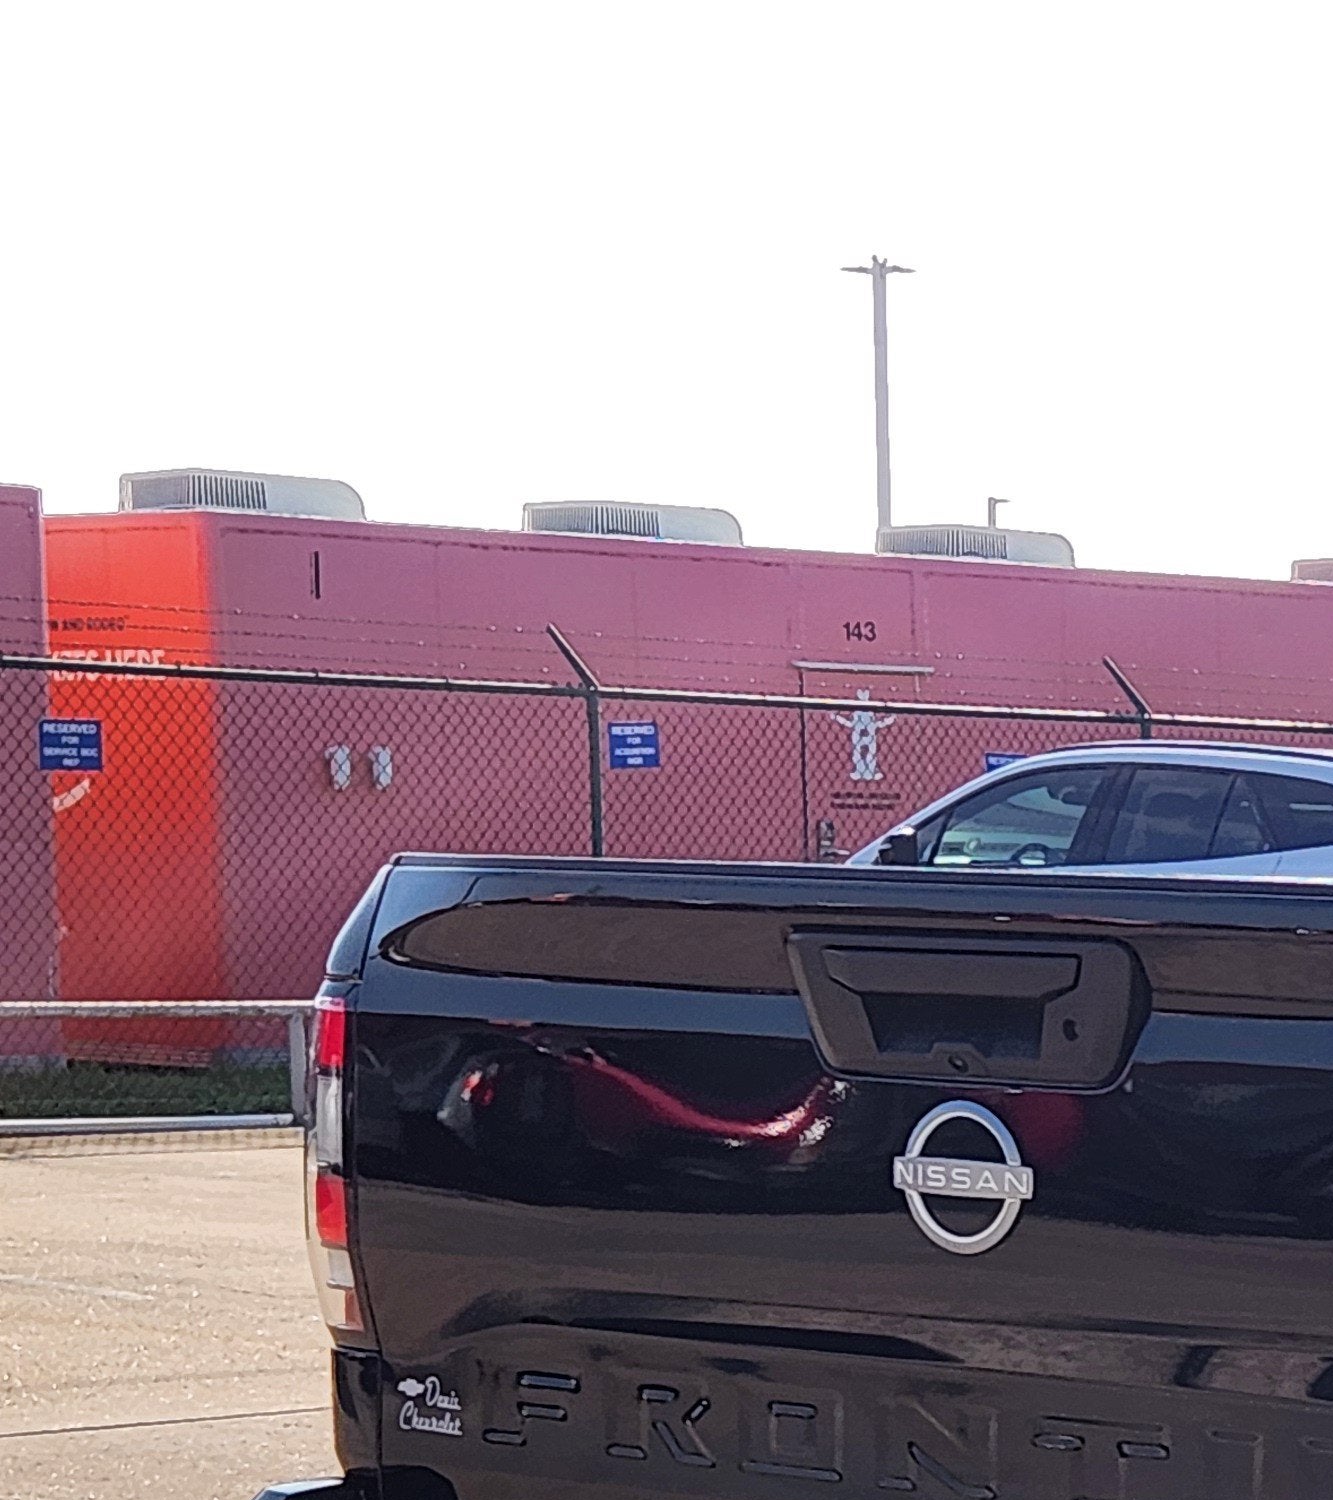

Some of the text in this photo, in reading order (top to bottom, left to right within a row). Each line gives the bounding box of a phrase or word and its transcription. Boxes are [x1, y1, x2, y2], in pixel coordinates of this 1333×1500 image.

[843, 621, 876, 642] 143
[43, 722, 98, 735] RESERVED
[894, 1161, 1028, 1194] NISSAN
[425, 1376, 462, 1410] Davis
[399, 1401, 463, 1436] Chevrolet
